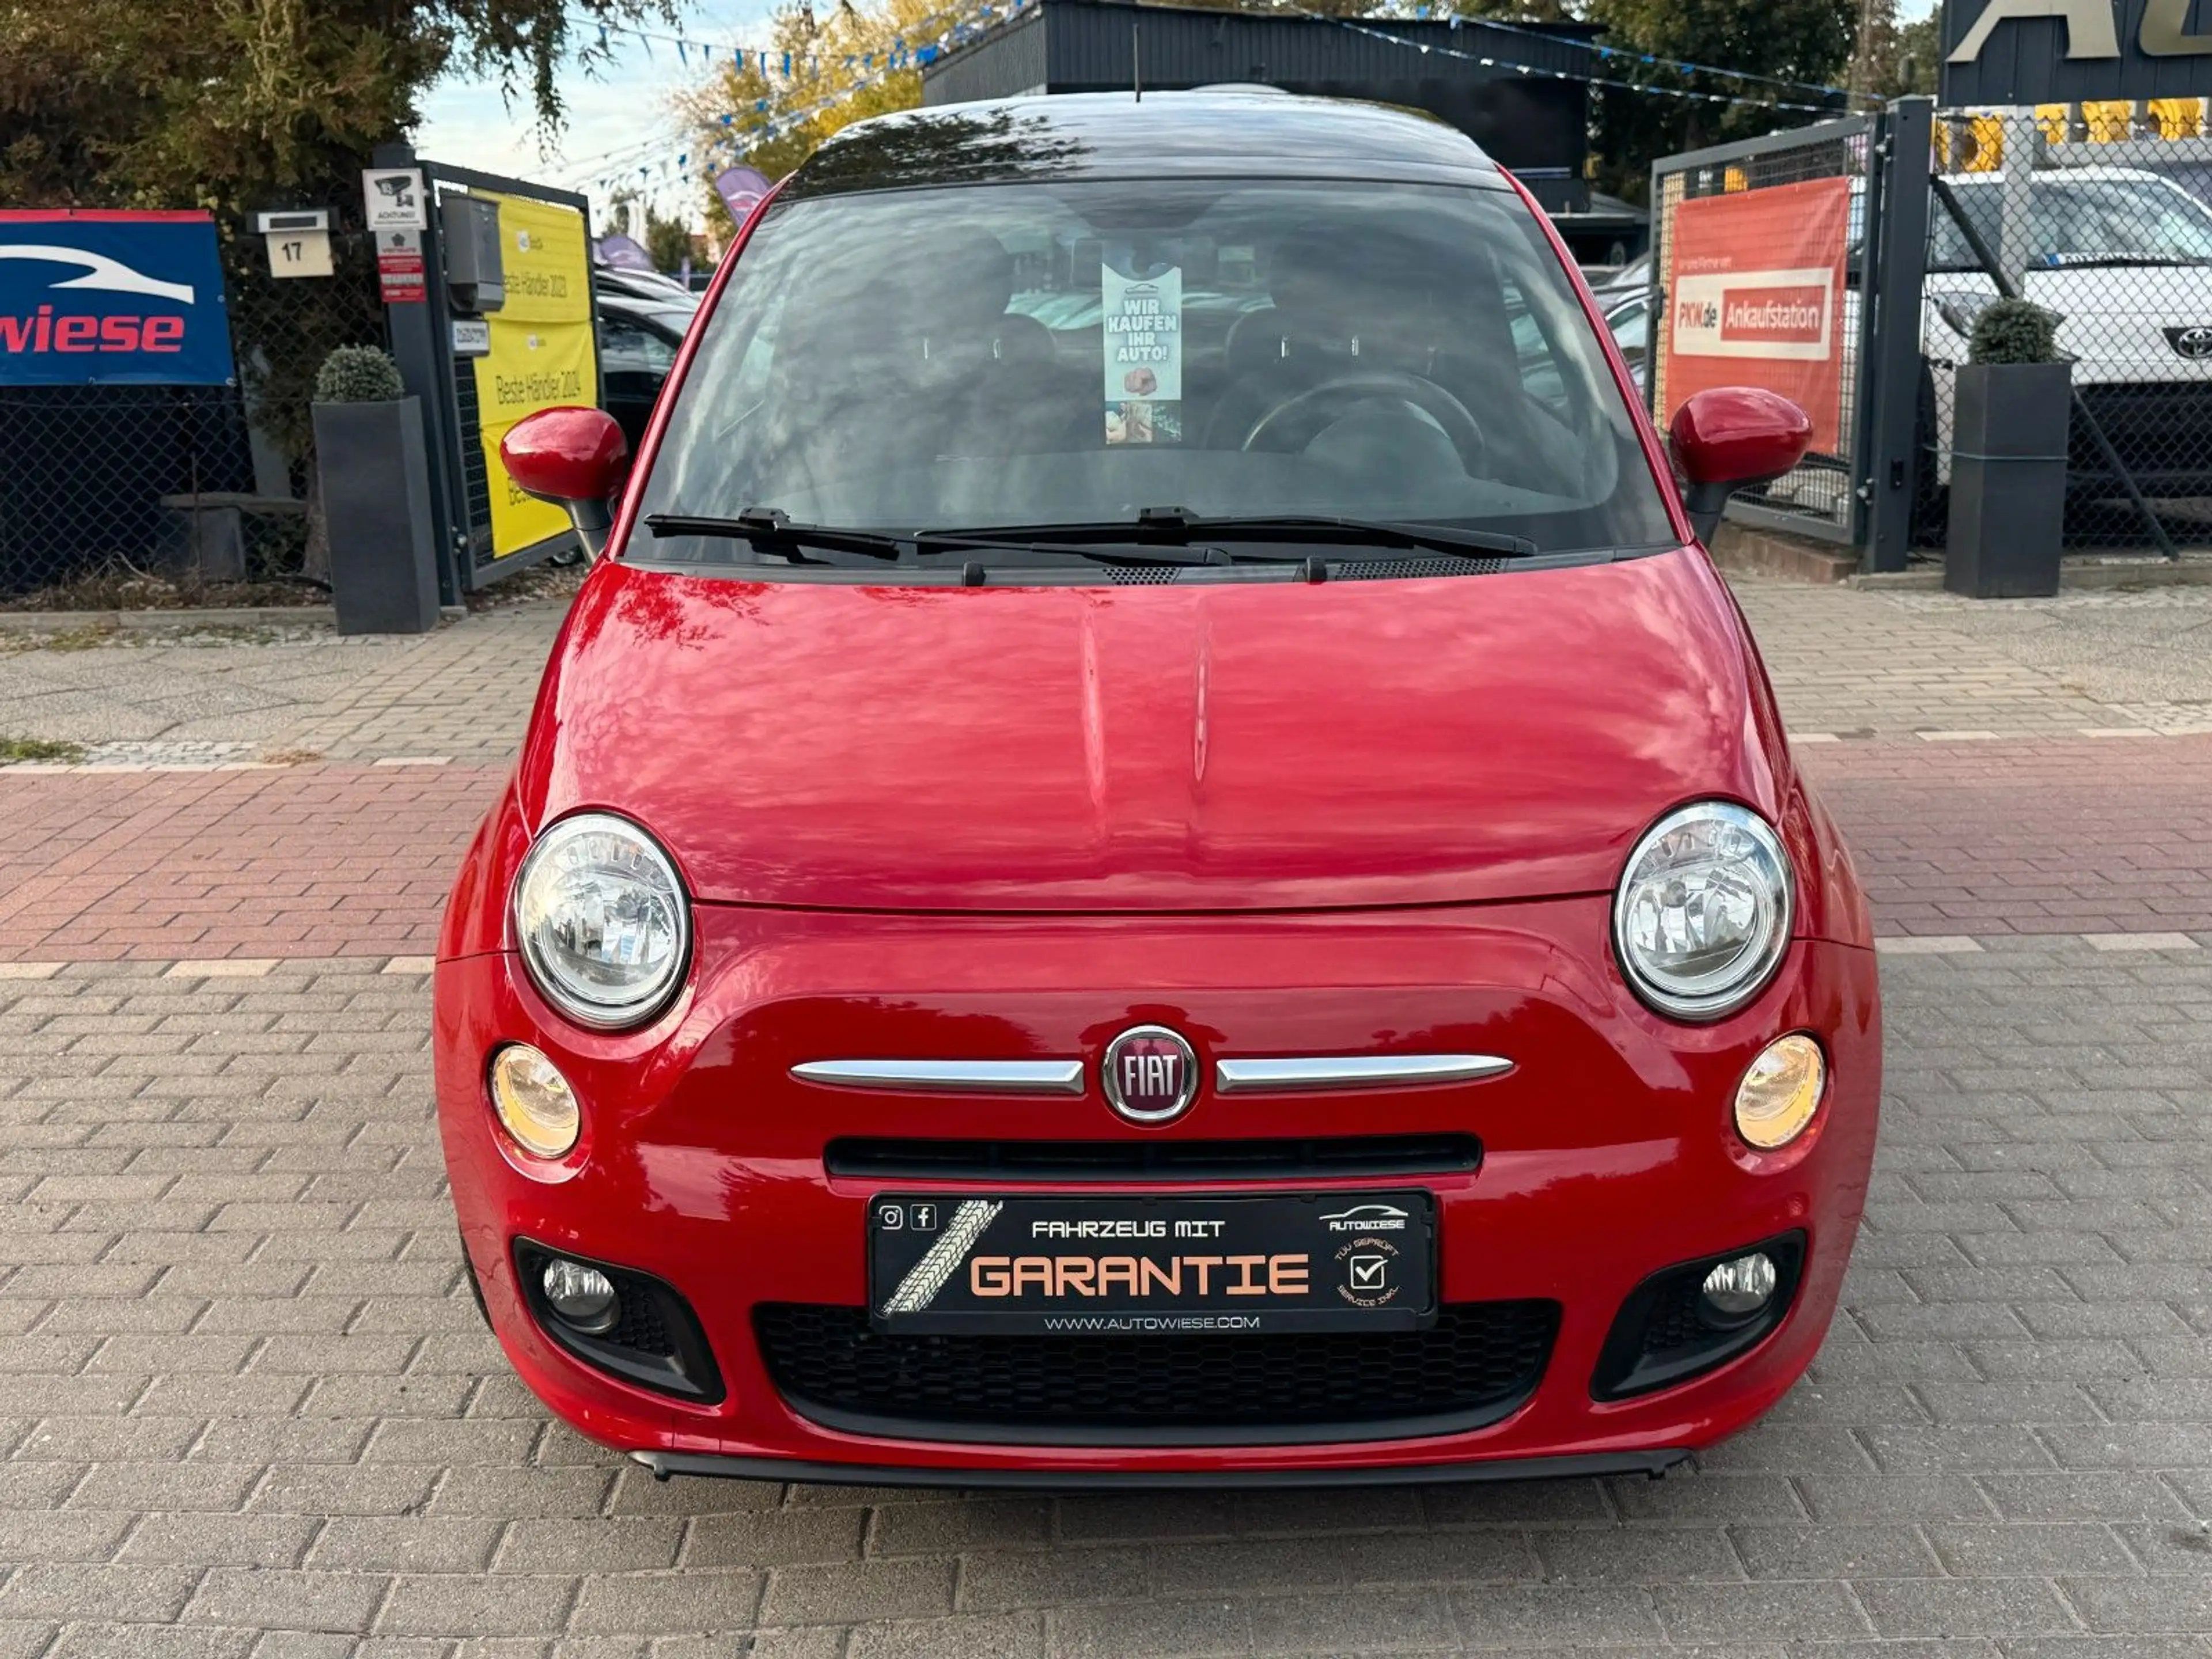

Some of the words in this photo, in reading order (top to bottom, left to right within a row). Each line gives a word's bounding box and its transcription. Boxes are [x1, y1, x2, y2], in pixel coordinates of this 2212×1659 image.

[282, 242, 302, 262] 17
[1124, 300, 1160, 315] WIR
[1679, 301, 1718, 329] PKW.de
[1725, 297, 1819, 329] Ankaufstation
[1108, 316, 1177, 333] KAUFEN
[1128, 332, 1156, 347] IHR
[1117, 346, 1168, 362] AUTO!
[496, 375, 524, 405] Beste
[525, 372, 559, 402] Händler
[1124, 1055, 1177, 1096] FIAT
[1032, 1220, 1166, 1238] FAHRZEUG
[1175, 1221, 1225, 1238] MIT
[1330, 1219, 1406, 1232] AUTOWIESE
[970, 1254, 1309, 1297] GARANTIE
[1336, 1284, 1376, 1307] SERVICE
[1044, 1316, 1260, 1330] WWW.AUTOWIESE.COM
